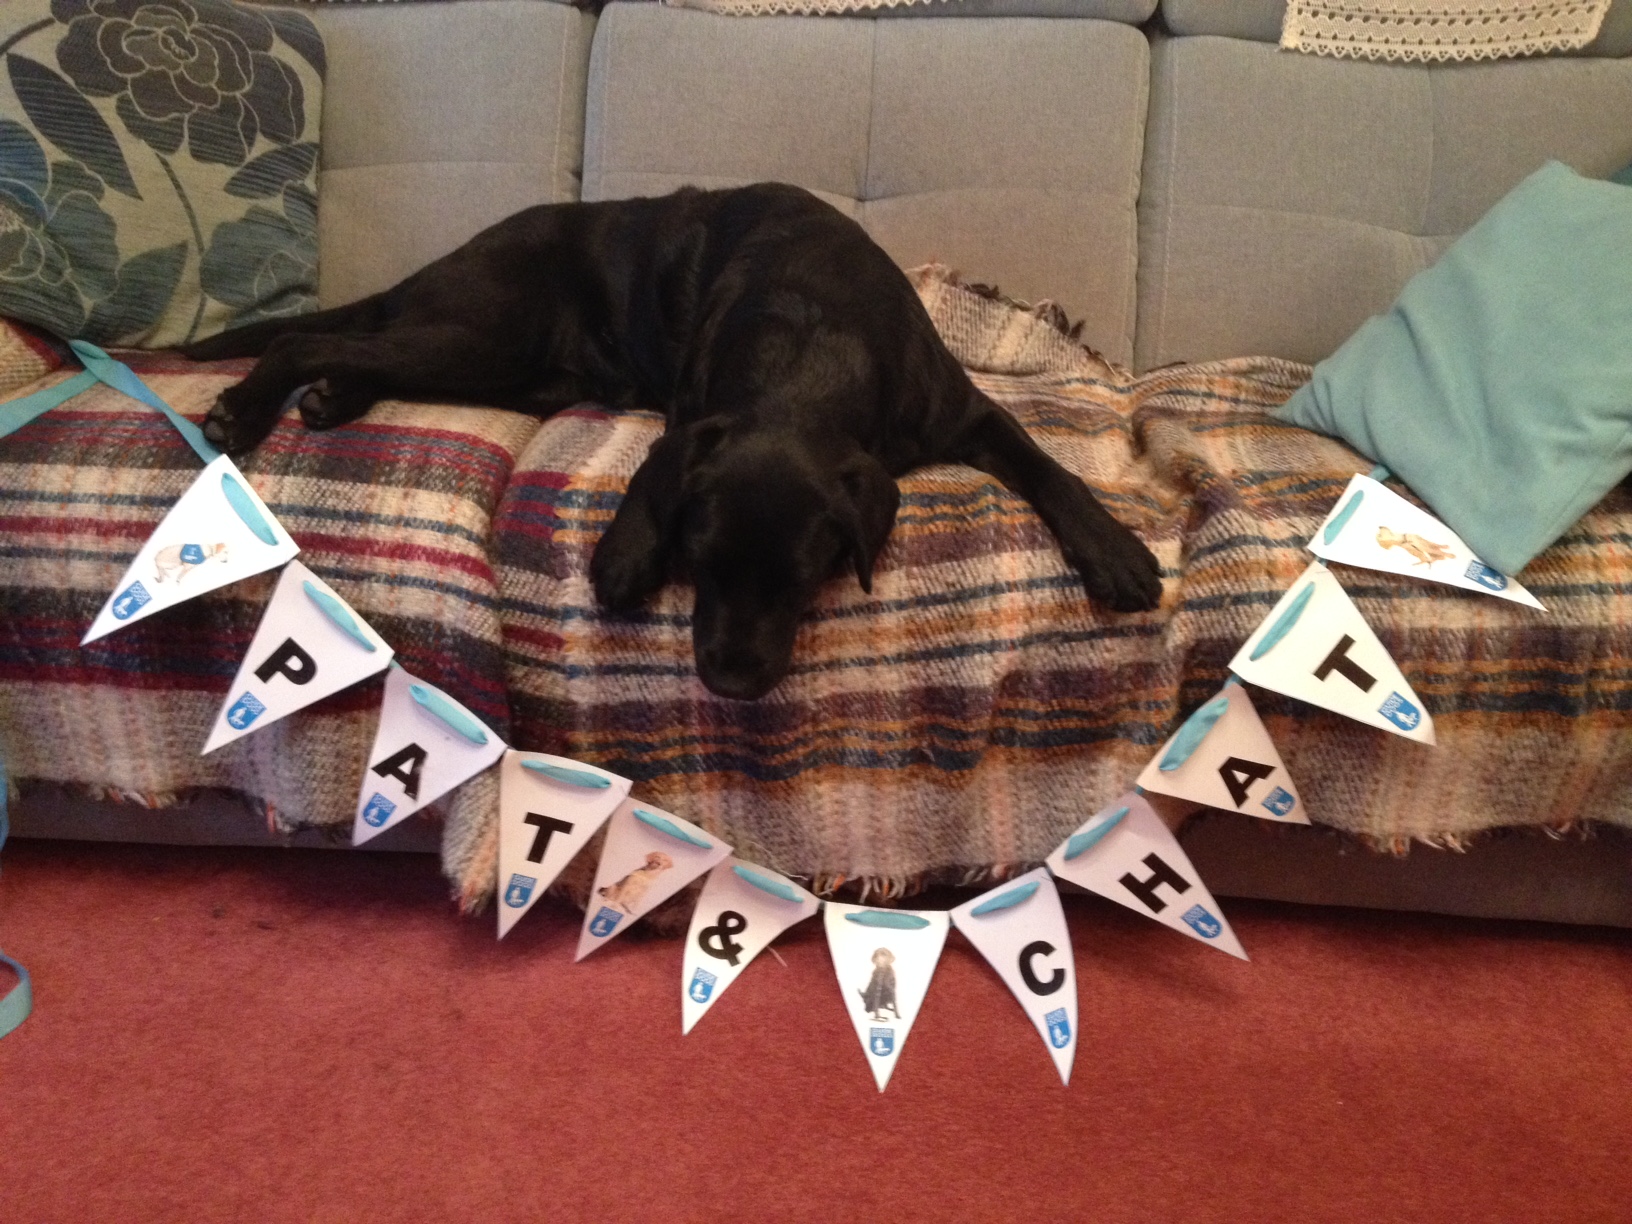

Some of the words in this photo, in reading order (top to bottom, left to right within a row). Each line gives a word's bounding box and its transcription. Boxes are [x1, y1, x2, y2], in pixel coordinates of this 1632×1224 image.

[254, 637, 317, 687] P
[371, 743, 428, 801] A
[523, 812, 575, 864] T
[698, 910, 748, 967] &
[1018, 940, 1066, 997] C
[1118, 852, 1192, 913] H
[1218, 757, 1276, 809] A
[1312, 634, 1376, 692] T
